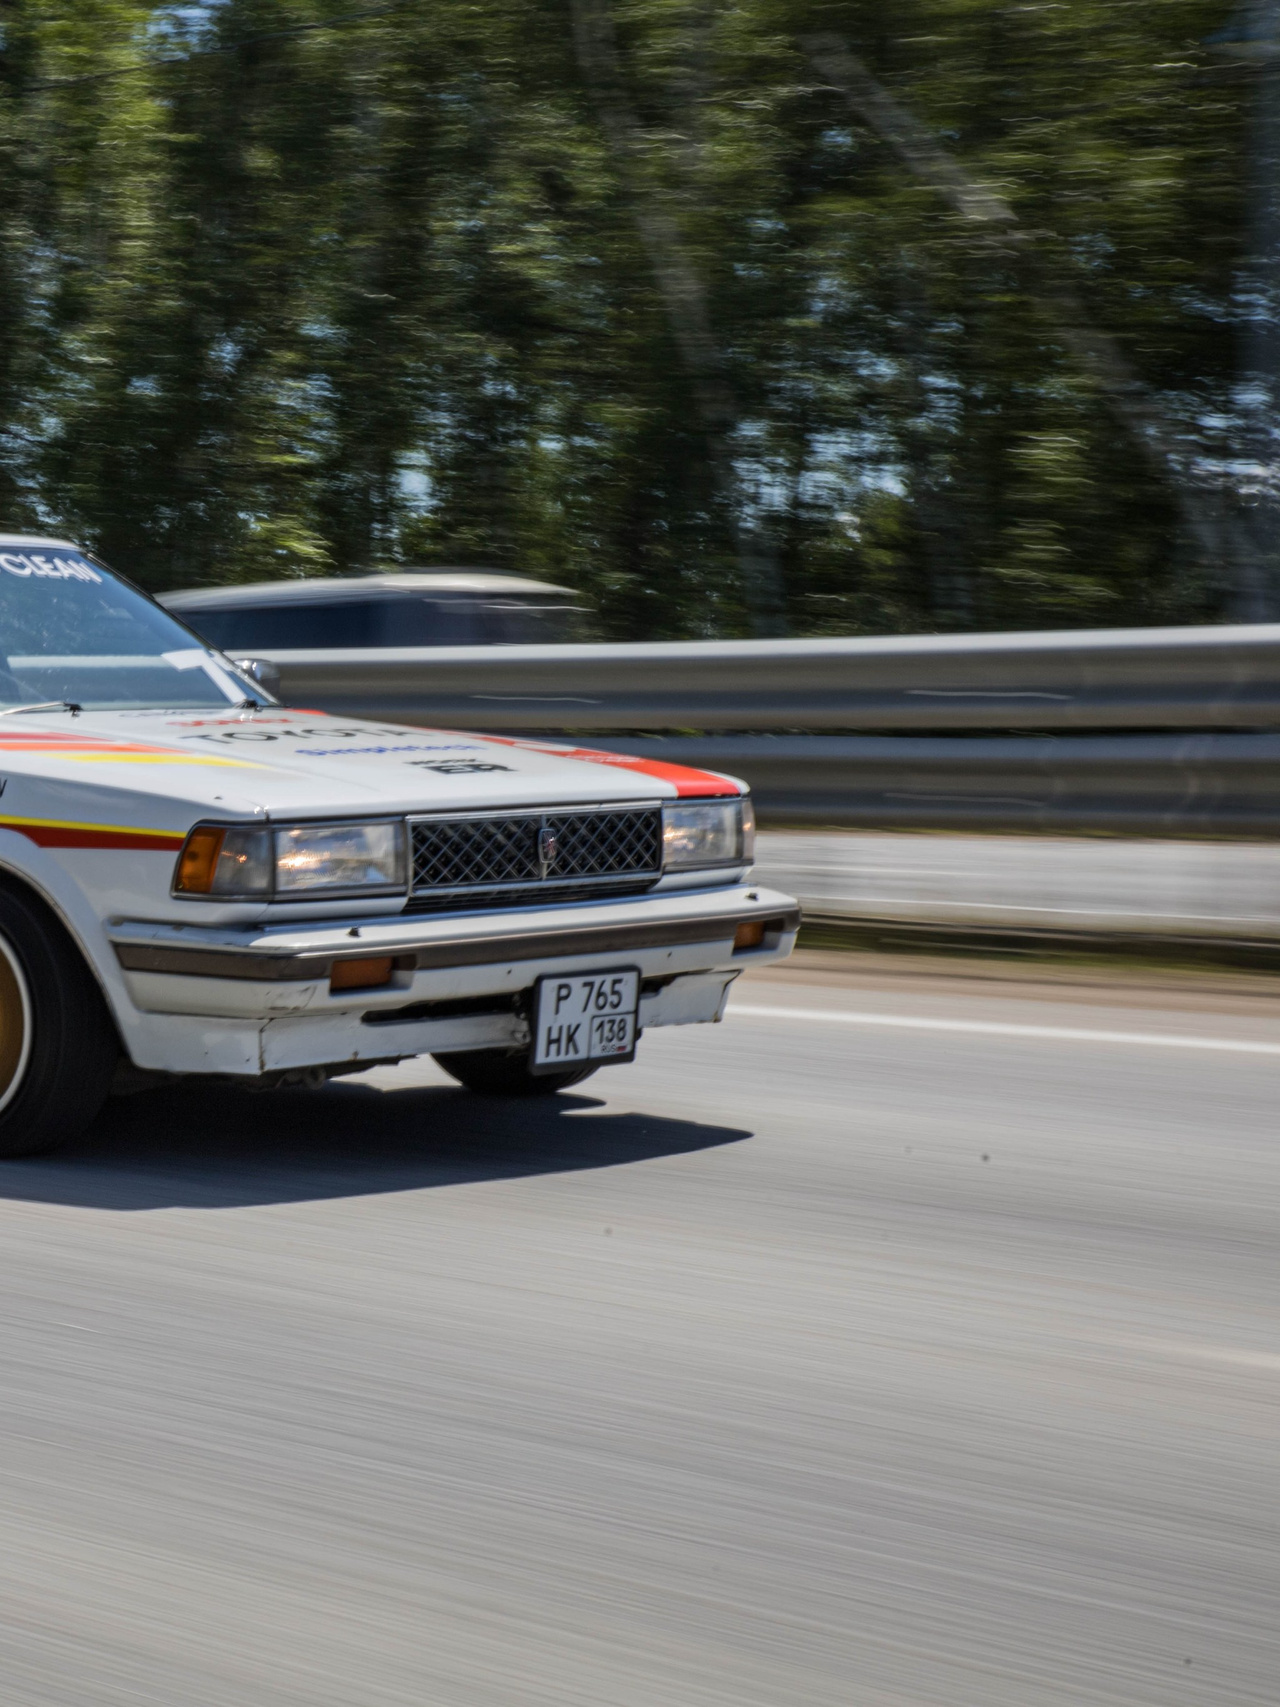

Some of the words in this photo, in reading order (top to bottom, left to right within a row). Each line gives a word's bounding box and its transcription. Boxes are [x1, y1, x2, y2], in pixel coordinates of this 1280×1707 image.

[178, 728, 432, 745] TOYOTA
[582, 978, 624, 1013] 765
[595, 1018, 628, 1045] 138
[601, 1044, 617, 1053] RUS
